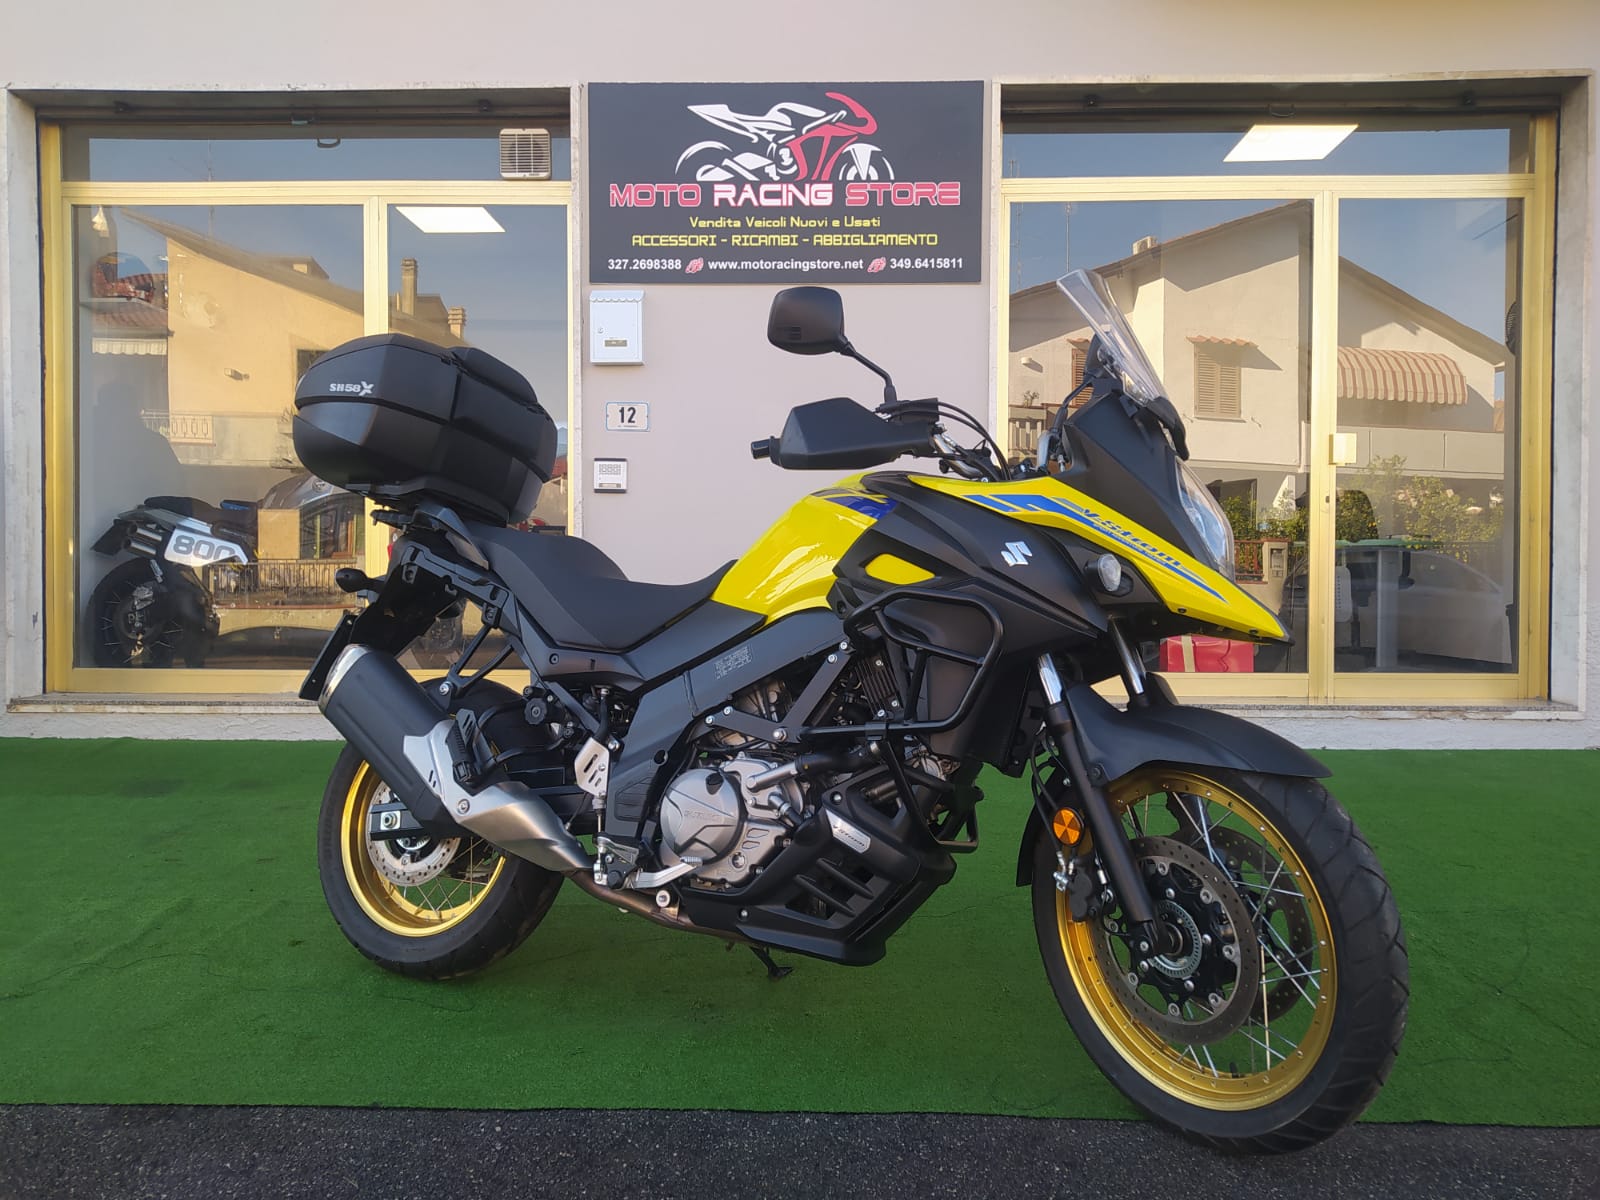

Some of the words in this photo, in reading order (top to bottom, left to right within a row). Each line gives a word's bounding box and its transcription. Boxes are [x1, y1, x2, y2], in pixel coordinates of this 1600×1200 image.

[609, 183, 702, 208] MOTO
[713, 182, 834, 208] RACING
[845, 181, 961, 207] STORE
[689, 216, 742, 228] Vendita
[745, 216, 787, 228] Veicoli
[790, 216, 828, 228] Nuovi
[831, 218, 841, 228] e
[844, 215, 881, 228] Usati
[632, 234, 717, 247] ACCESSORI
[731, 234, 799, 247] RICAMBI
[813, 233, 938, 246] ABBIGLIAMENTO
[607, 258, 682, 270] 327.2698388
[707, 258, 864, 272] www.motoracingstore.net
[889, 257, 963, 269] 349.6415811
[329, 380, 375, 396] SH58X
[618, 406, 636, 424] 12
